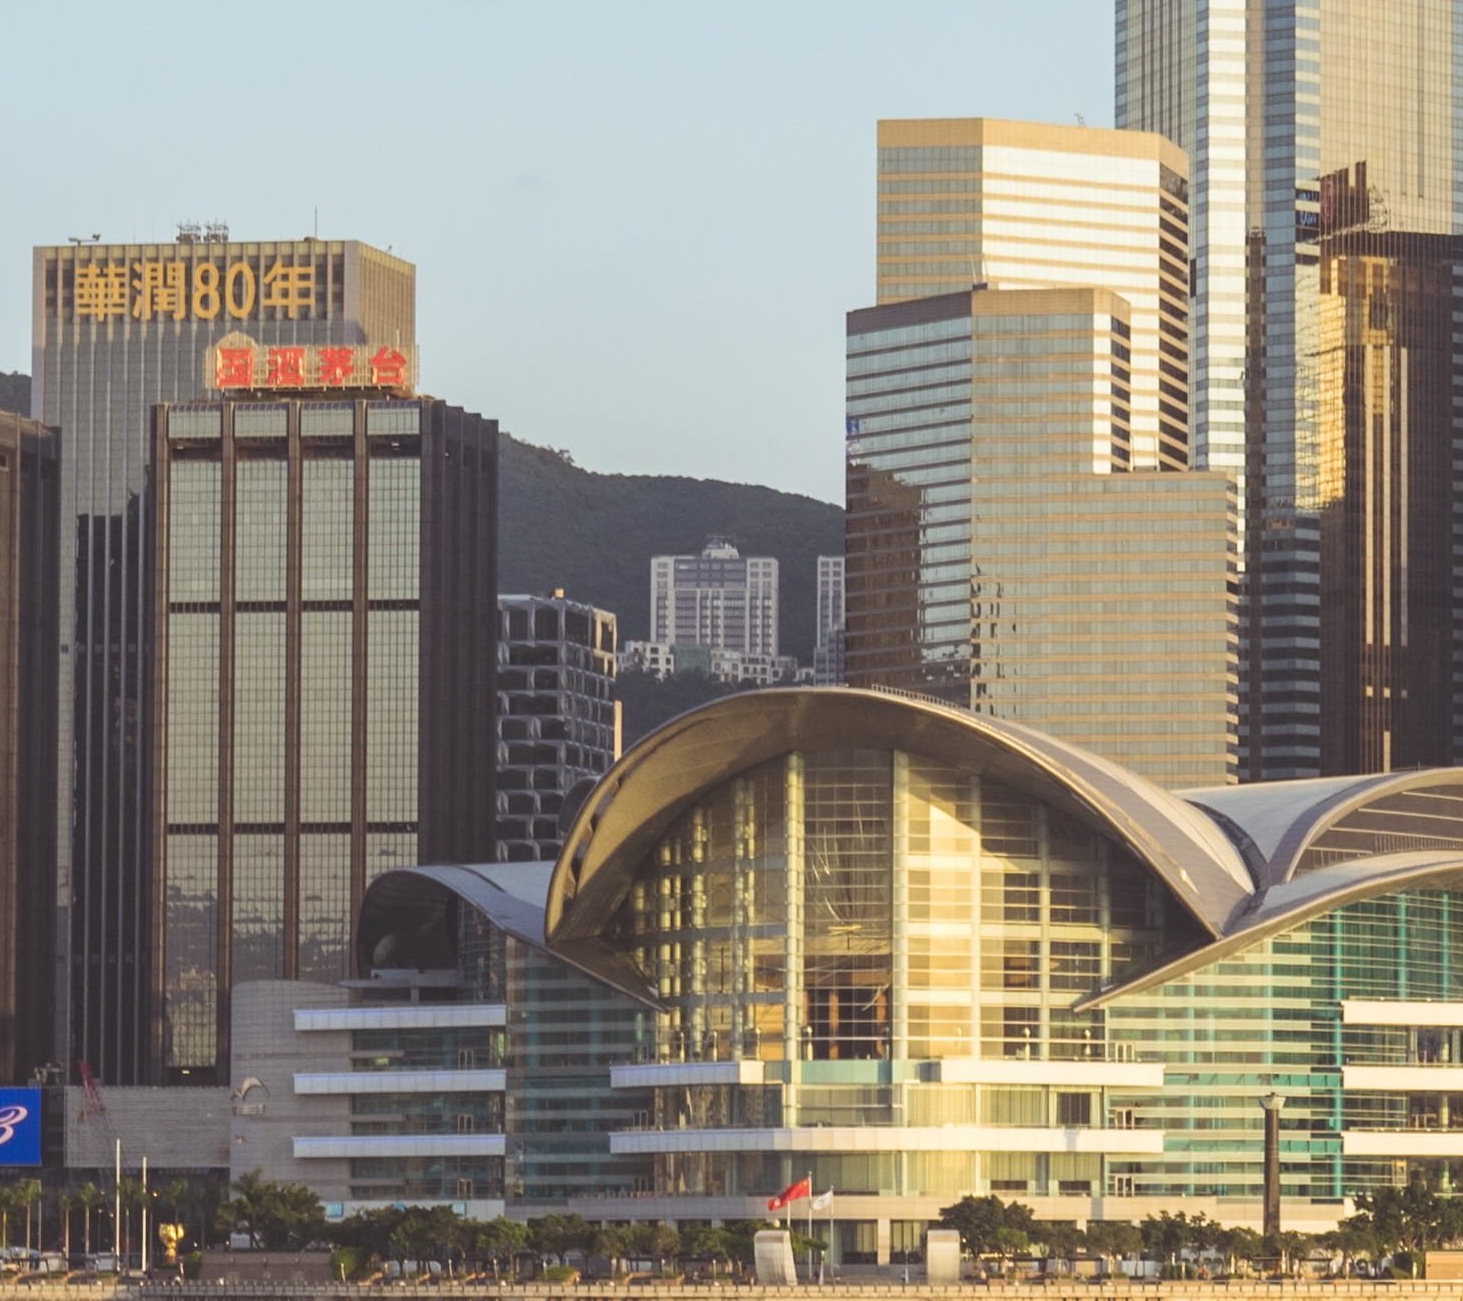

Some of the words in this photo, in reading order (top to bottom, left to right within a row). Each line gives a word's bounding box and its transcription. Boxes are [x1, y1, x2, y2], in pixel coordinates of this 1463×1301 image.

[74, 261, 316, 322] 華潤80年
[216, 347, 407, 387] 国酒茅台
